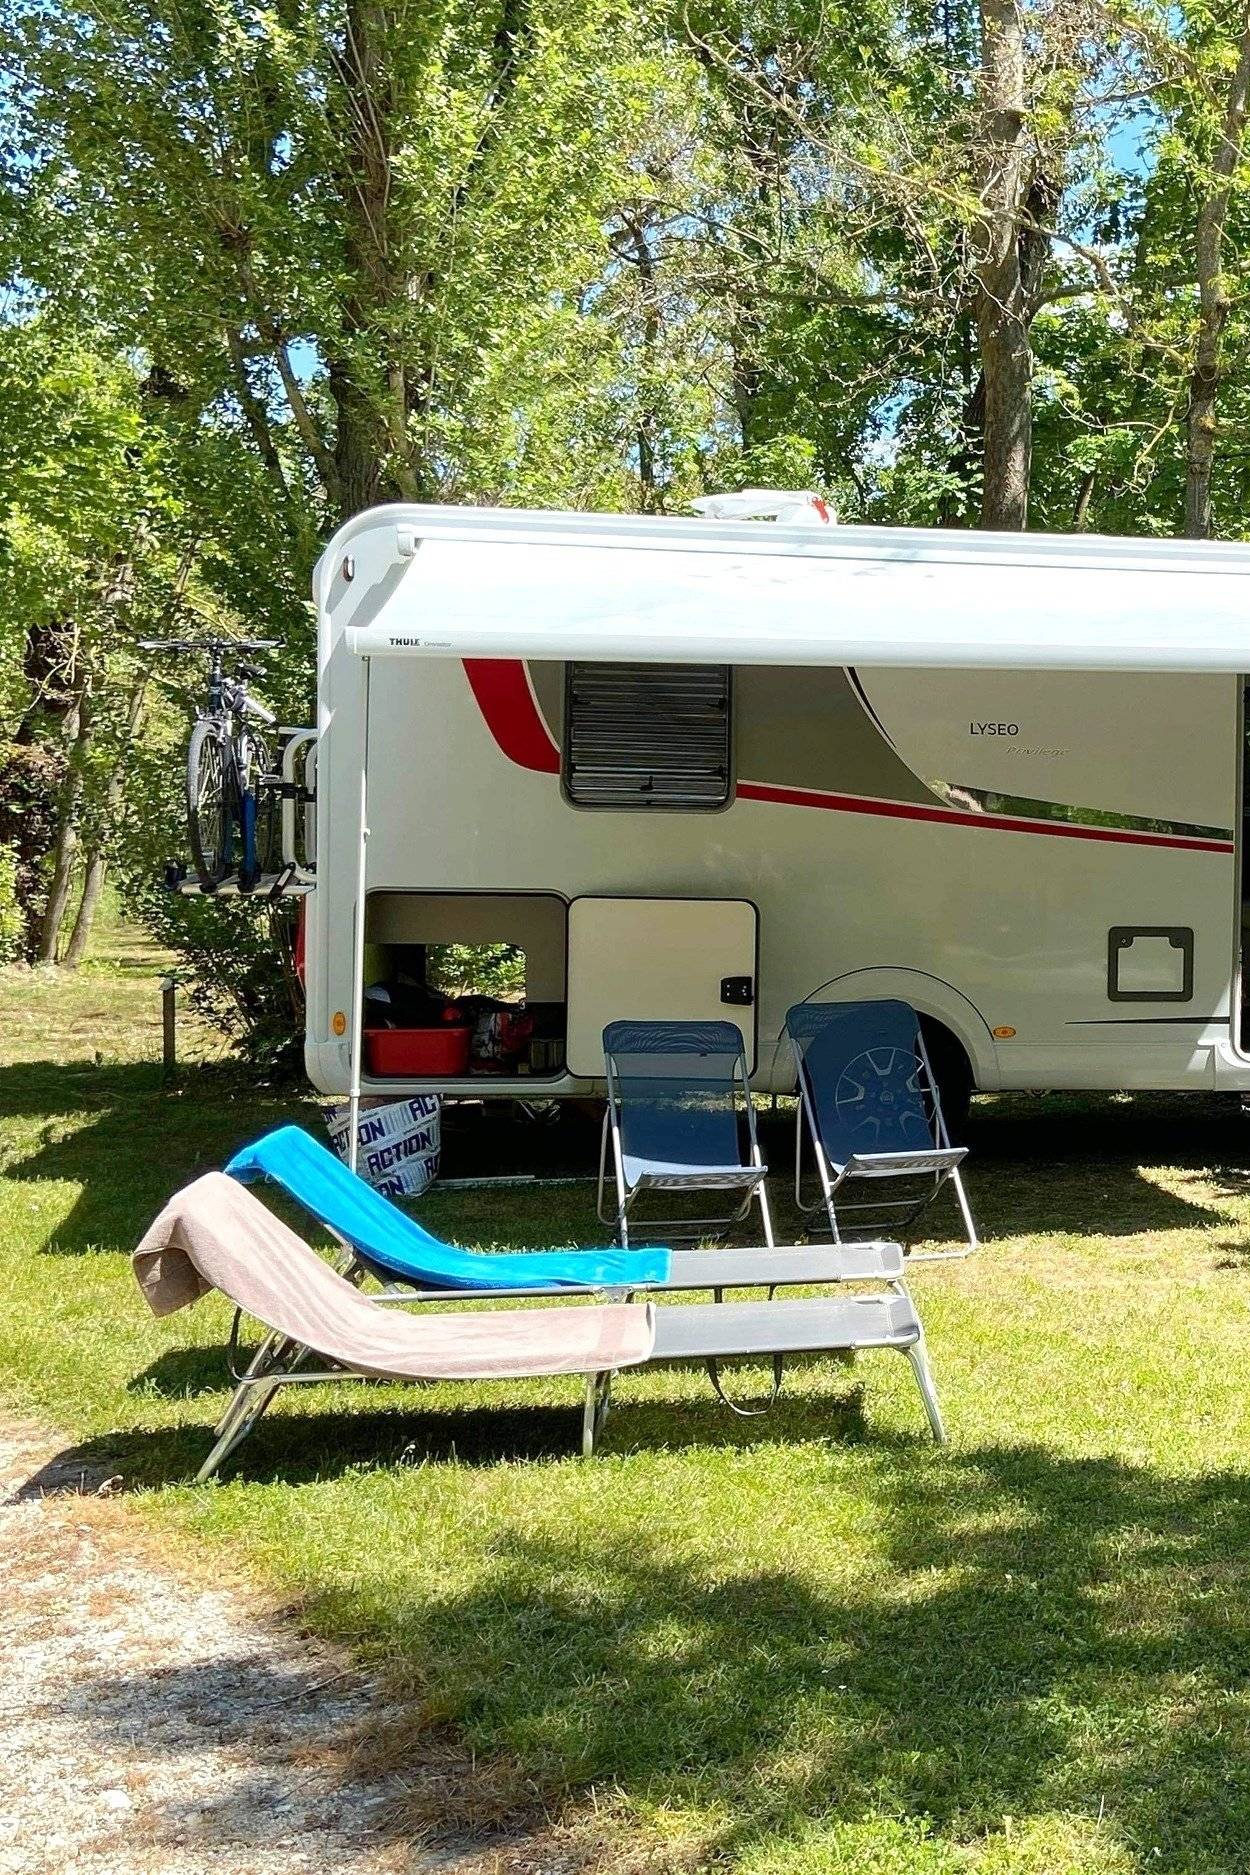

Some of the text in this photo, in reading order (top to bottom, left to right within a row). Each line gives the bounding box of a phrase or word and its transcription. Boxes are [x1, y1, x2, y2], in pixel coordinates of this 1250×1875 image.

[388, 637, 421, 647] THULE
[970, 722, 1019, 736] LYSEO
[367, 1128, 433, 1177] ACTION
